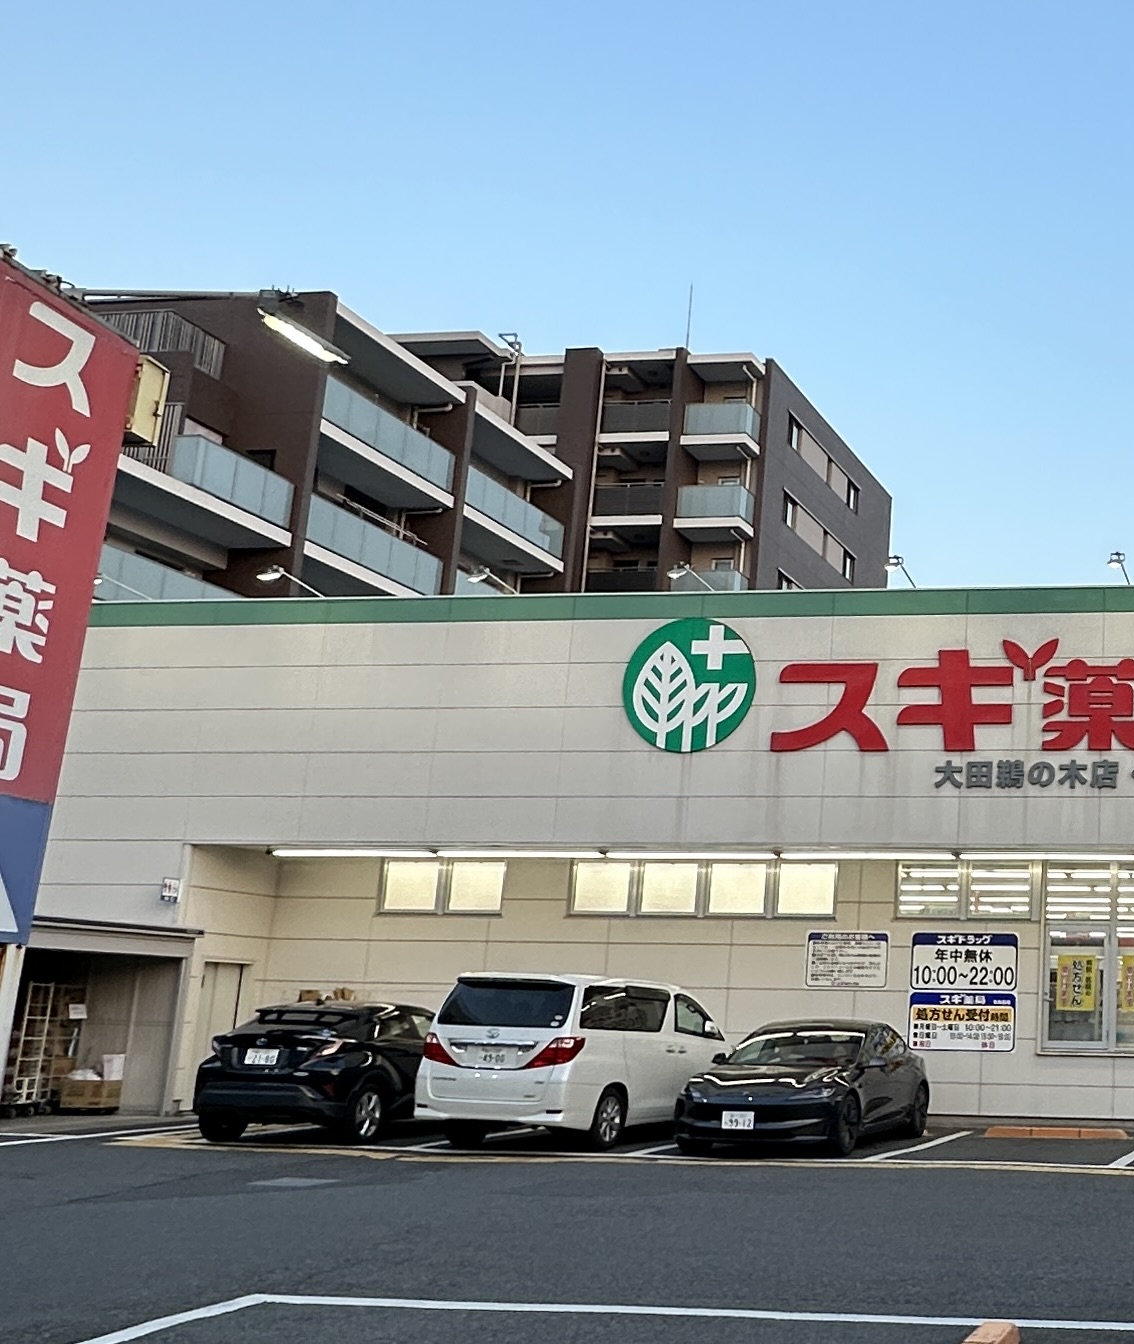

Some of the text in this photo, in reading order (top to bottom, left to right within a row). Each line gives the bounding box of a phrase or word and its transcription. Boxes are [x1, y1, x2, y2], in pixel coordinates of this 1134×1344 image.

[936, 935, 993, 944] スギドラッグ
[935, 948, 993, 963] 年中無休
[939, 993, 986, 1004] スギ薬局
